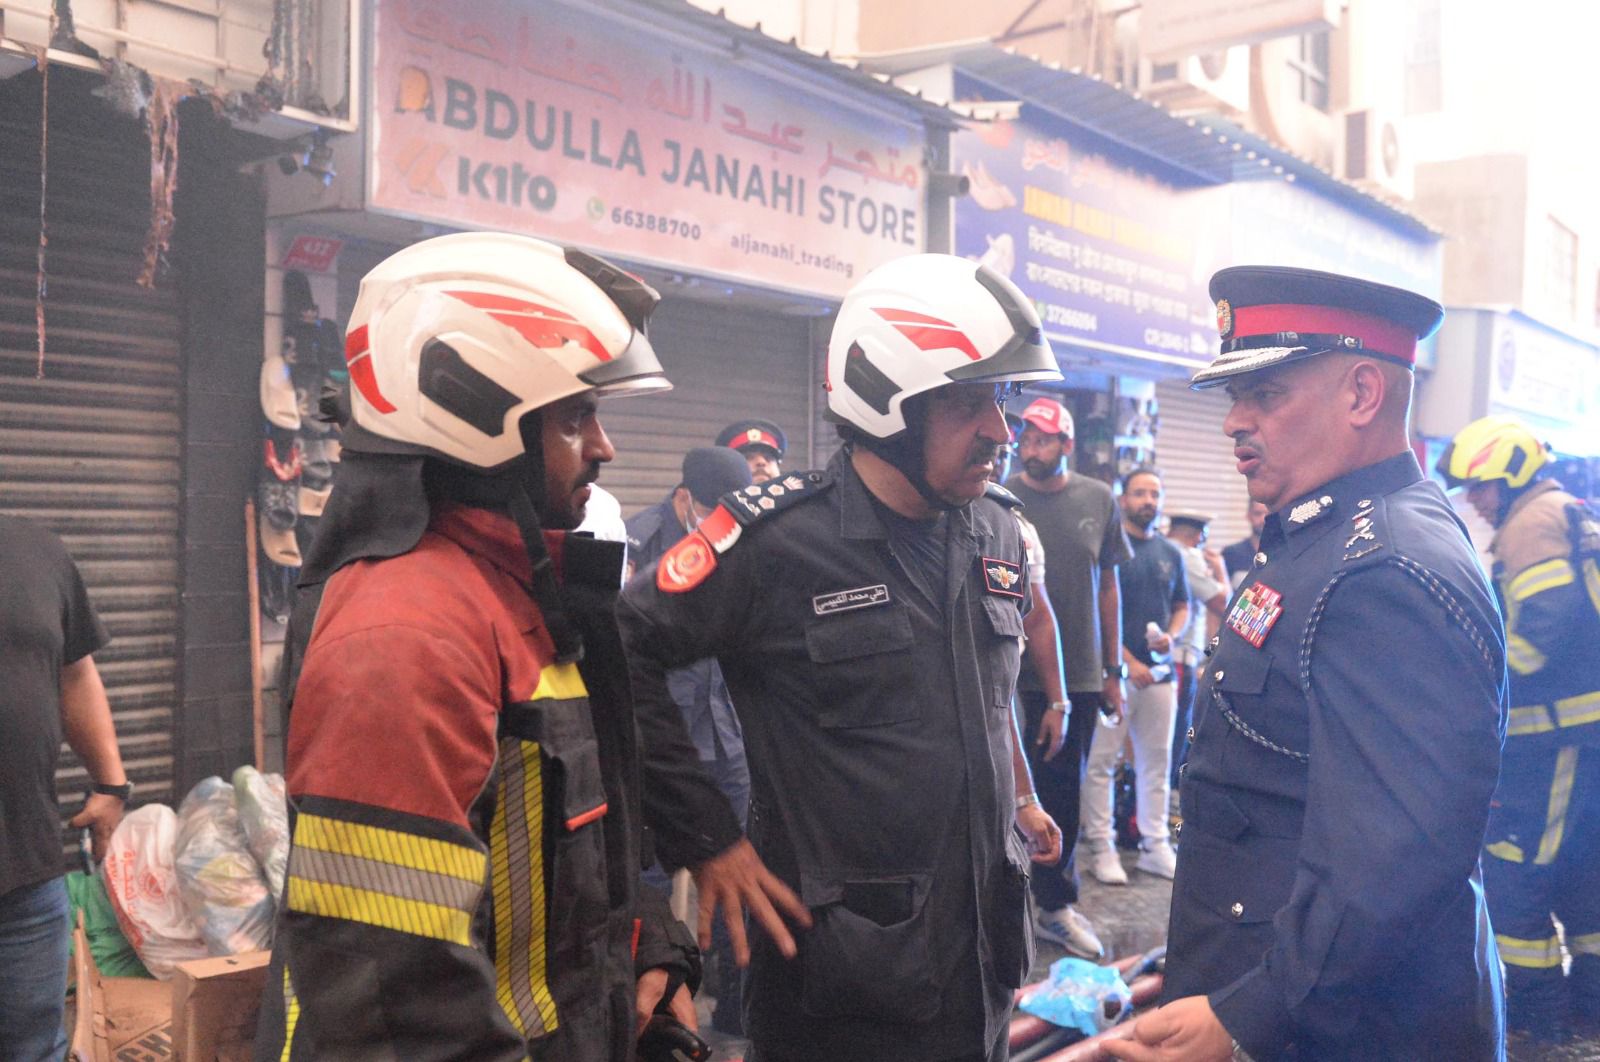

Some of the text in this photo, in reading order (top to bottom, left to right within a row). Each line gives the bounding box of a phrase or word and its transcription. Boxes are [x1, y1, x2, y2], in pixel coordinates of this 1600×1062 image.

[819, 141, 918, 190] متجر
[660, 139, 806, 217] JANAHI
[818, 184, 916, 247] STORE
[610, 206, 702, 241] 66388700
[730, 232, 854, 279] aljanahi_trading
[847, 593, 869, 601] محمد
